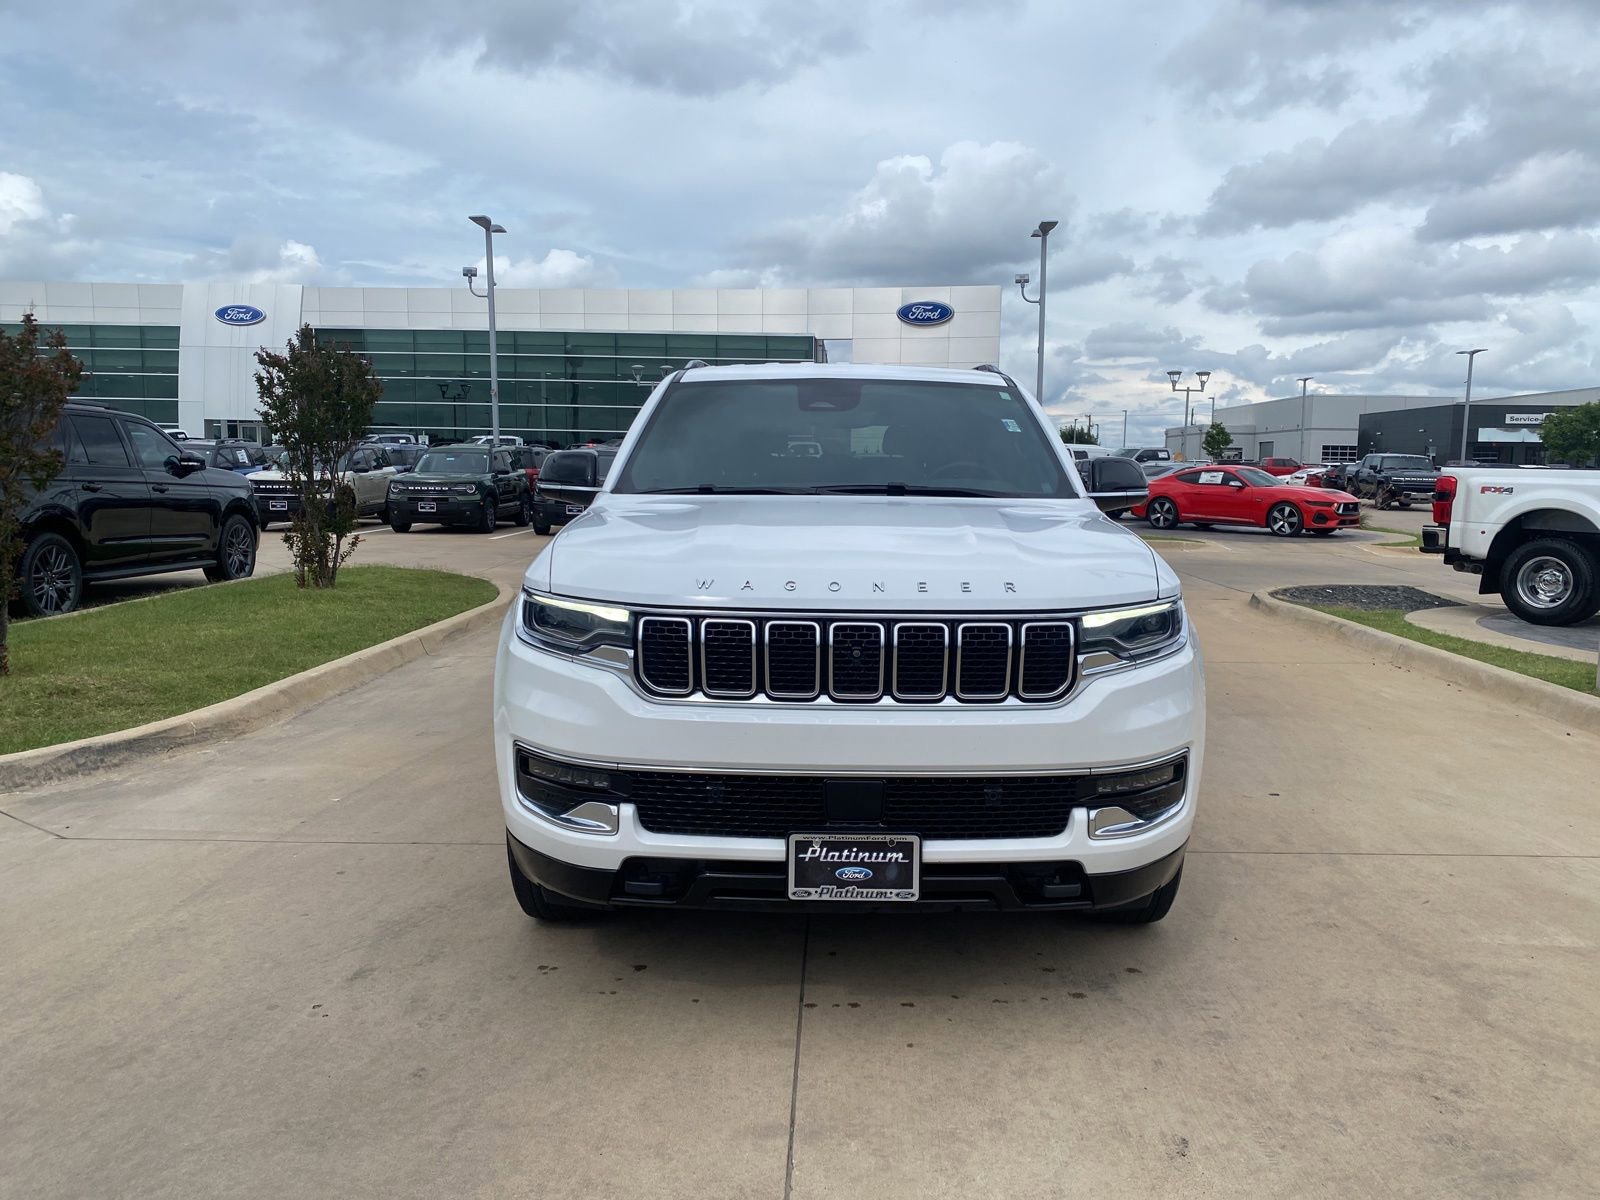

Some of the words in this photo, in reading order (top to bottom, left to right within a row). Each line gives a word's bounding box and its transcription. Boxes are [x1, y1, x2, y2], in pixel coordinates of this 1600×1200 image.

[224, 307, 253, 320] Ford
[908, 305, 941, 320] Ford
[1480, 486, 1514, 495] FX4
[695, 578, 1017, 593] WAGONEER
[798, 847, 910, 862] Platinum
[842, 868, 865, 879] Ford
[819, 886, 893, 899] Platinum
